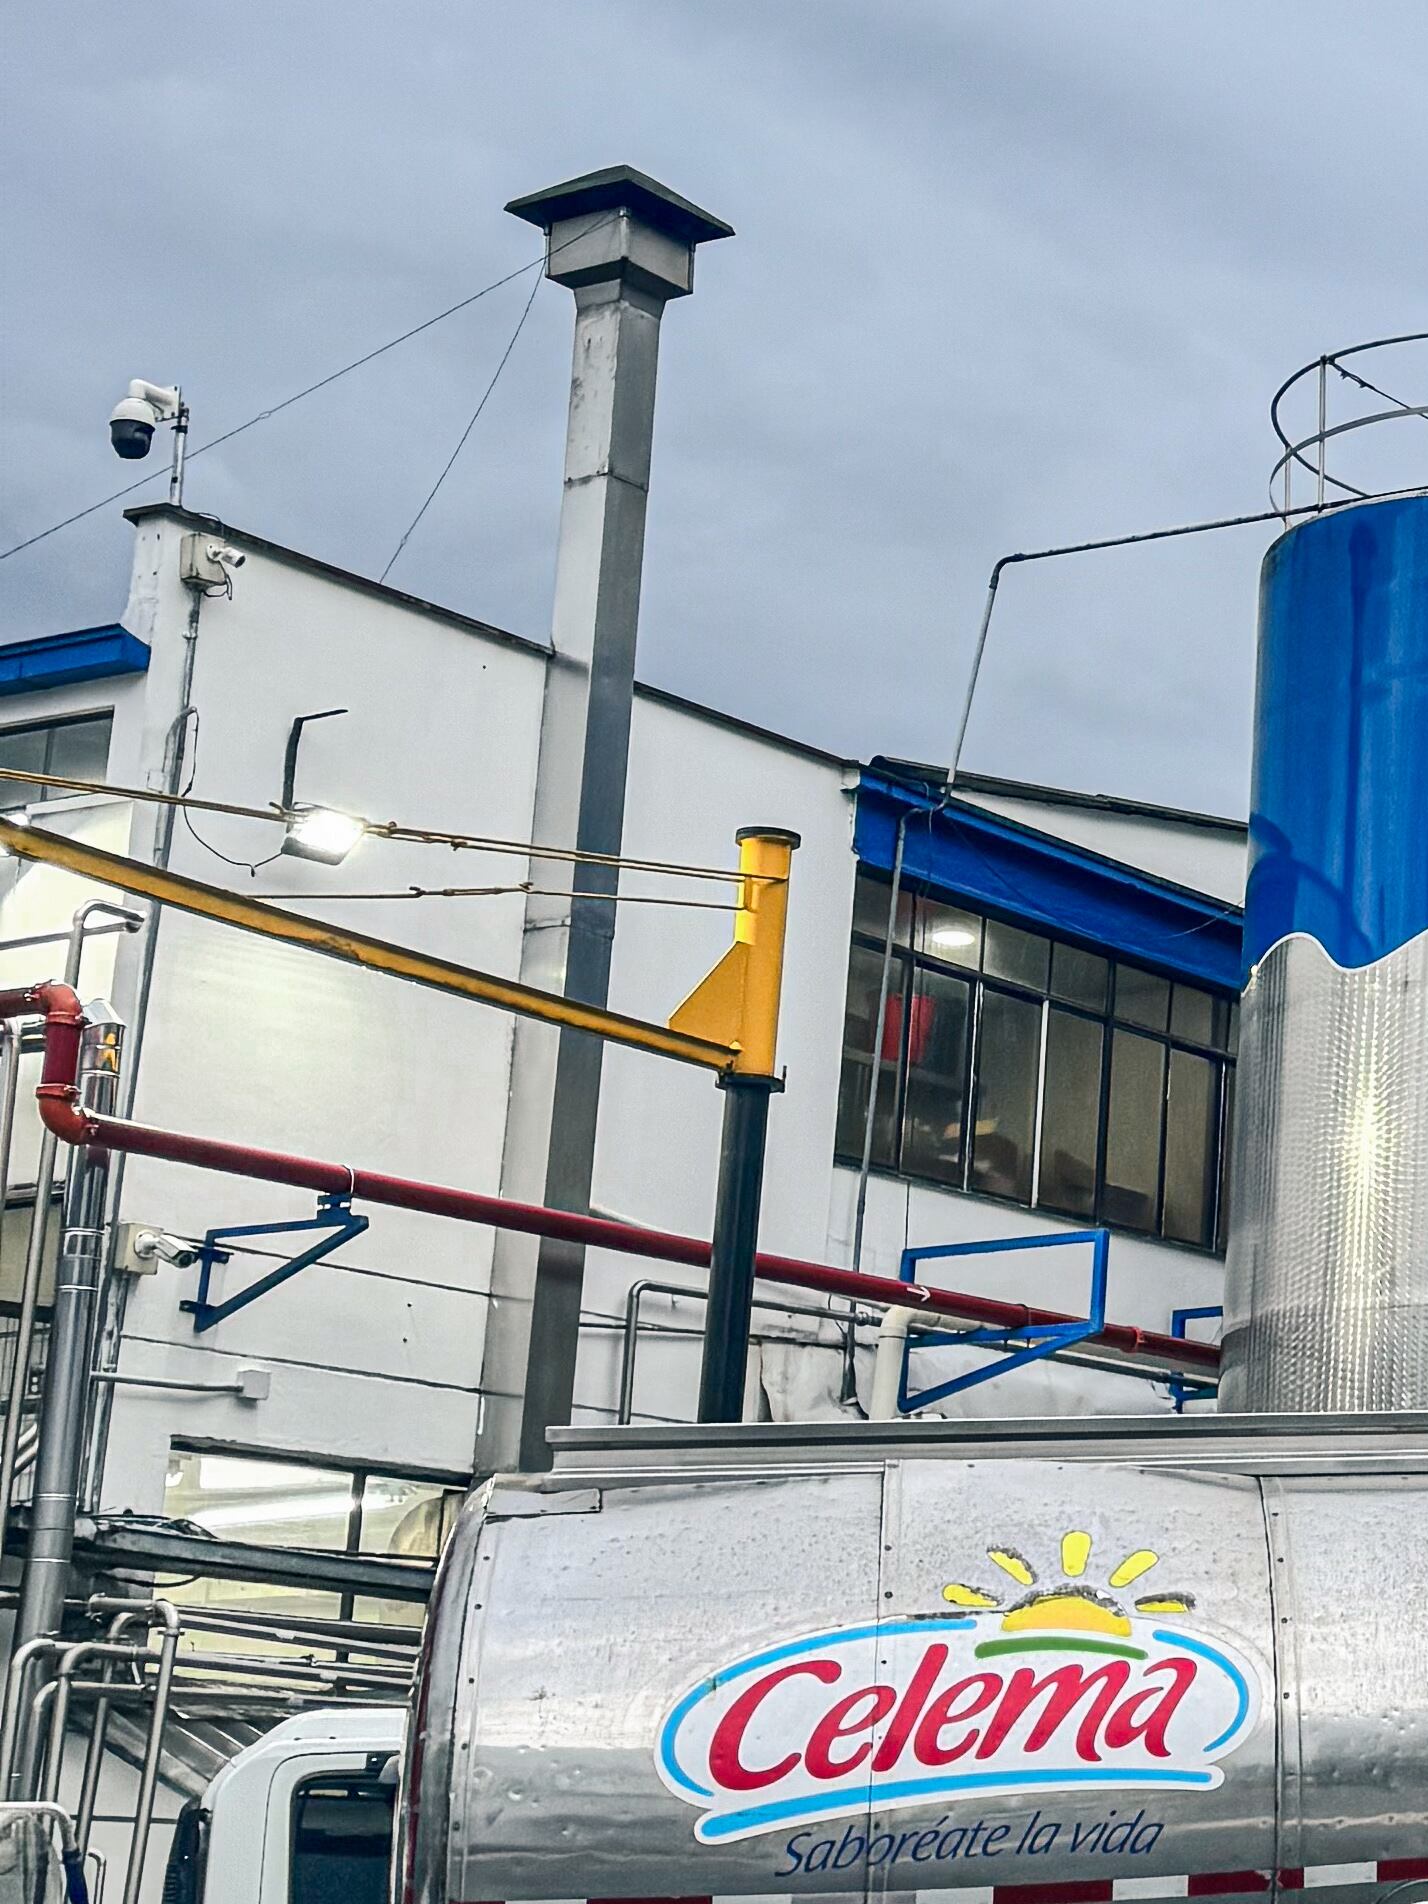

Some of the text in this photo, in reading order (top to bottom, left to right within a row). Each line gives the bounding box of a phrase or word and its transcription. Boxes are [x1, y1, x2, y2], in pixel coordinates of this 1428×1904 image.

[708, 1643, 1198, 1791] Celema
[774, 1809, 1166, 1878] Saboréate la vida
